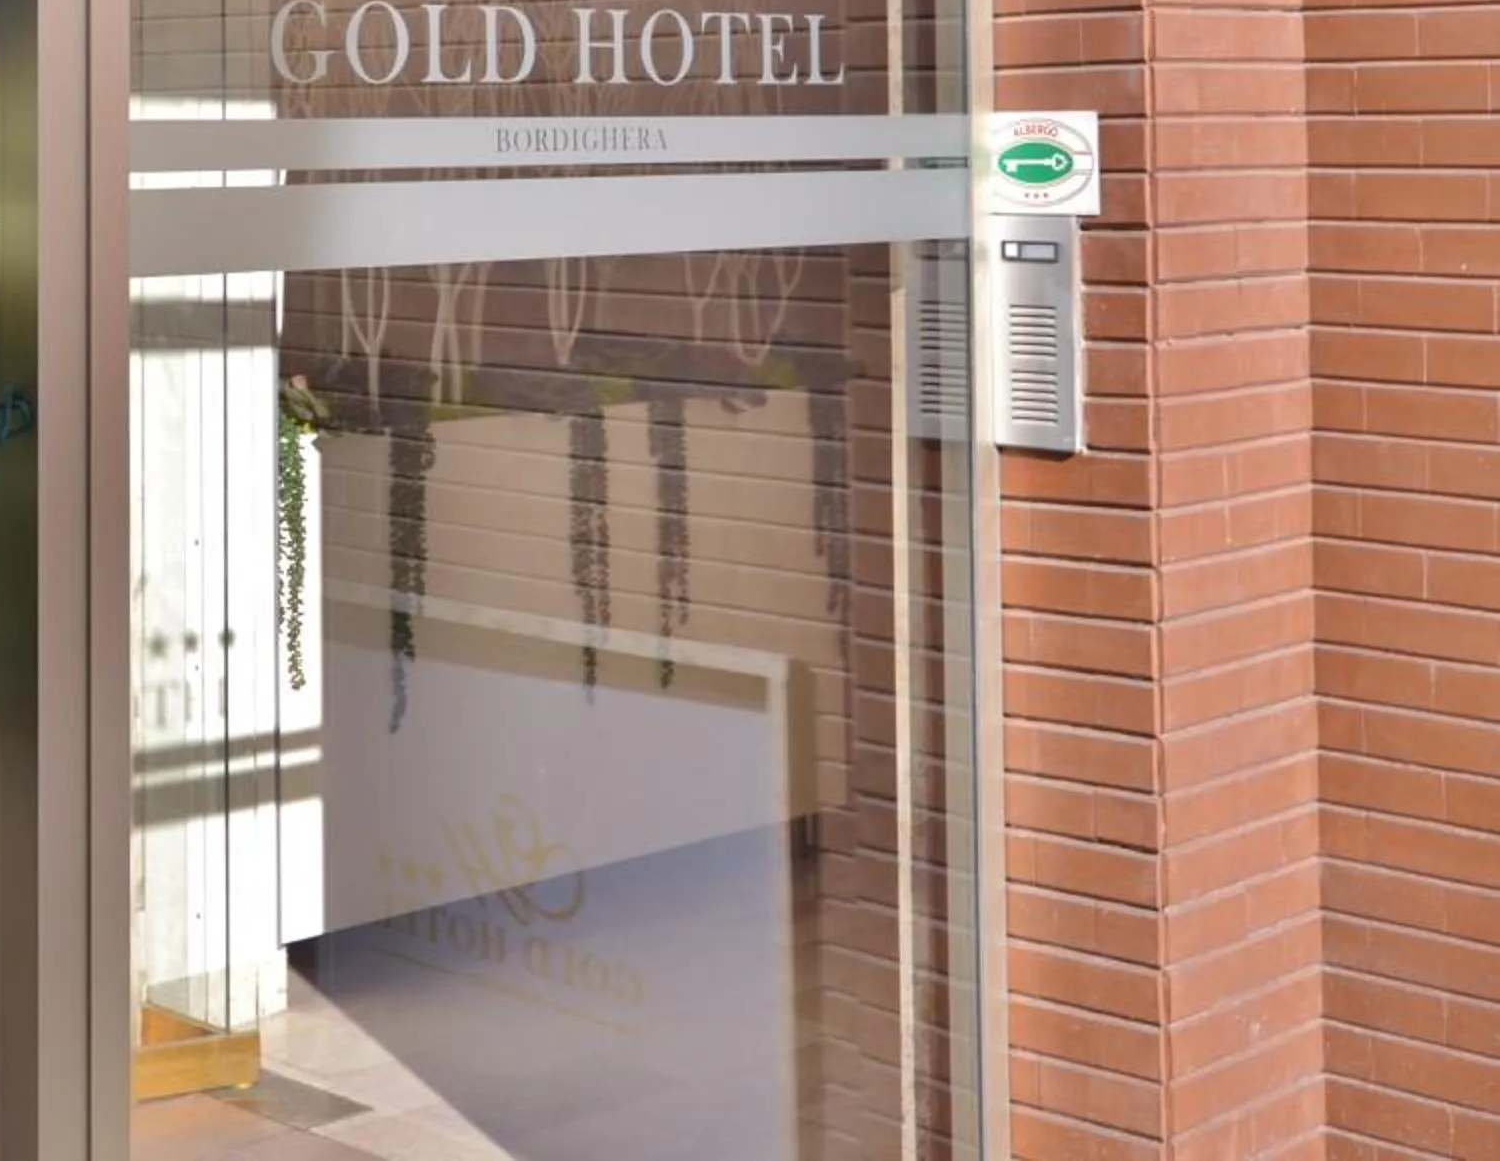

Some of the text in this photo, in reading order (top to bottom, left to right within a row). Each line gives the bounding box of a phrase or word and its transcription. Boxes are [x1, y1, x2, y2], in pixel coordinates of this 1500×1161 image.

[573, 7, 845, 85] HOTEL
[496, 126, 668, 152] BORDIGHERA
[1013, 125, 1059, 138] ALBERGO
